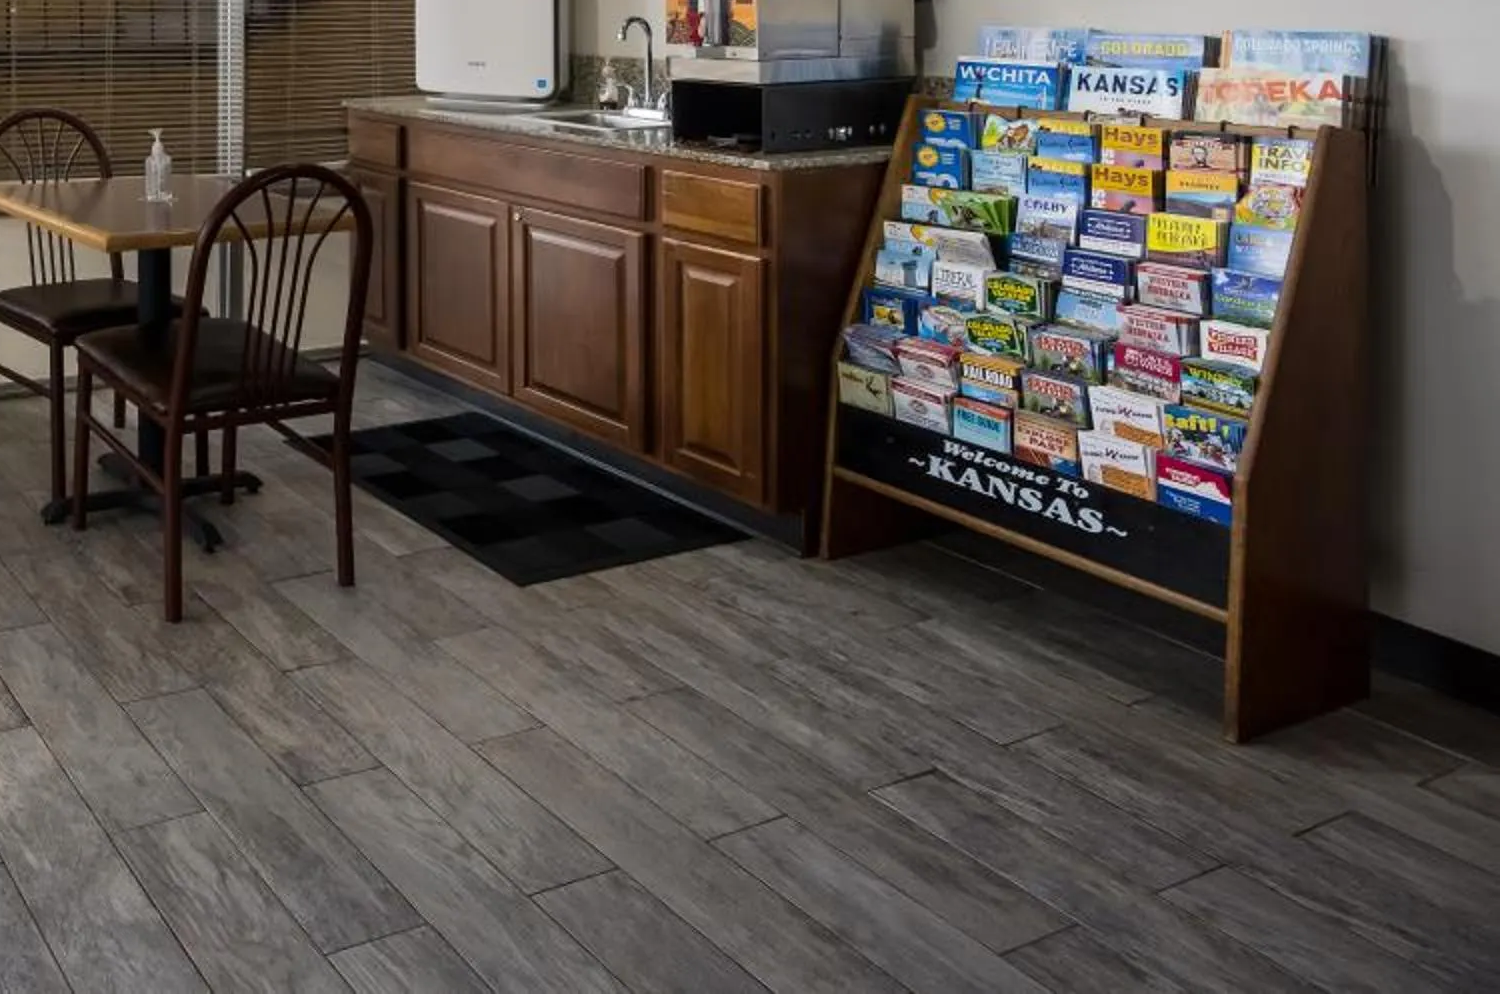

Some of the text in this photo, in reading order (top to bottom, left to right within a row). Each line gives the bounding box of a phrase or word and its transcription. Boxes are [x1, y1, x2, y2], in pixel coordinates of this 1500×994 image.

[960, 64, 1051, 84] WICHITA
[1077, 72, 1179, 97] KANSAS
[1103, 125, 1158, 147] Hays
[1093, 166, 1149, 188] Hays
[942, 439, 1090, 500] Welcome To
